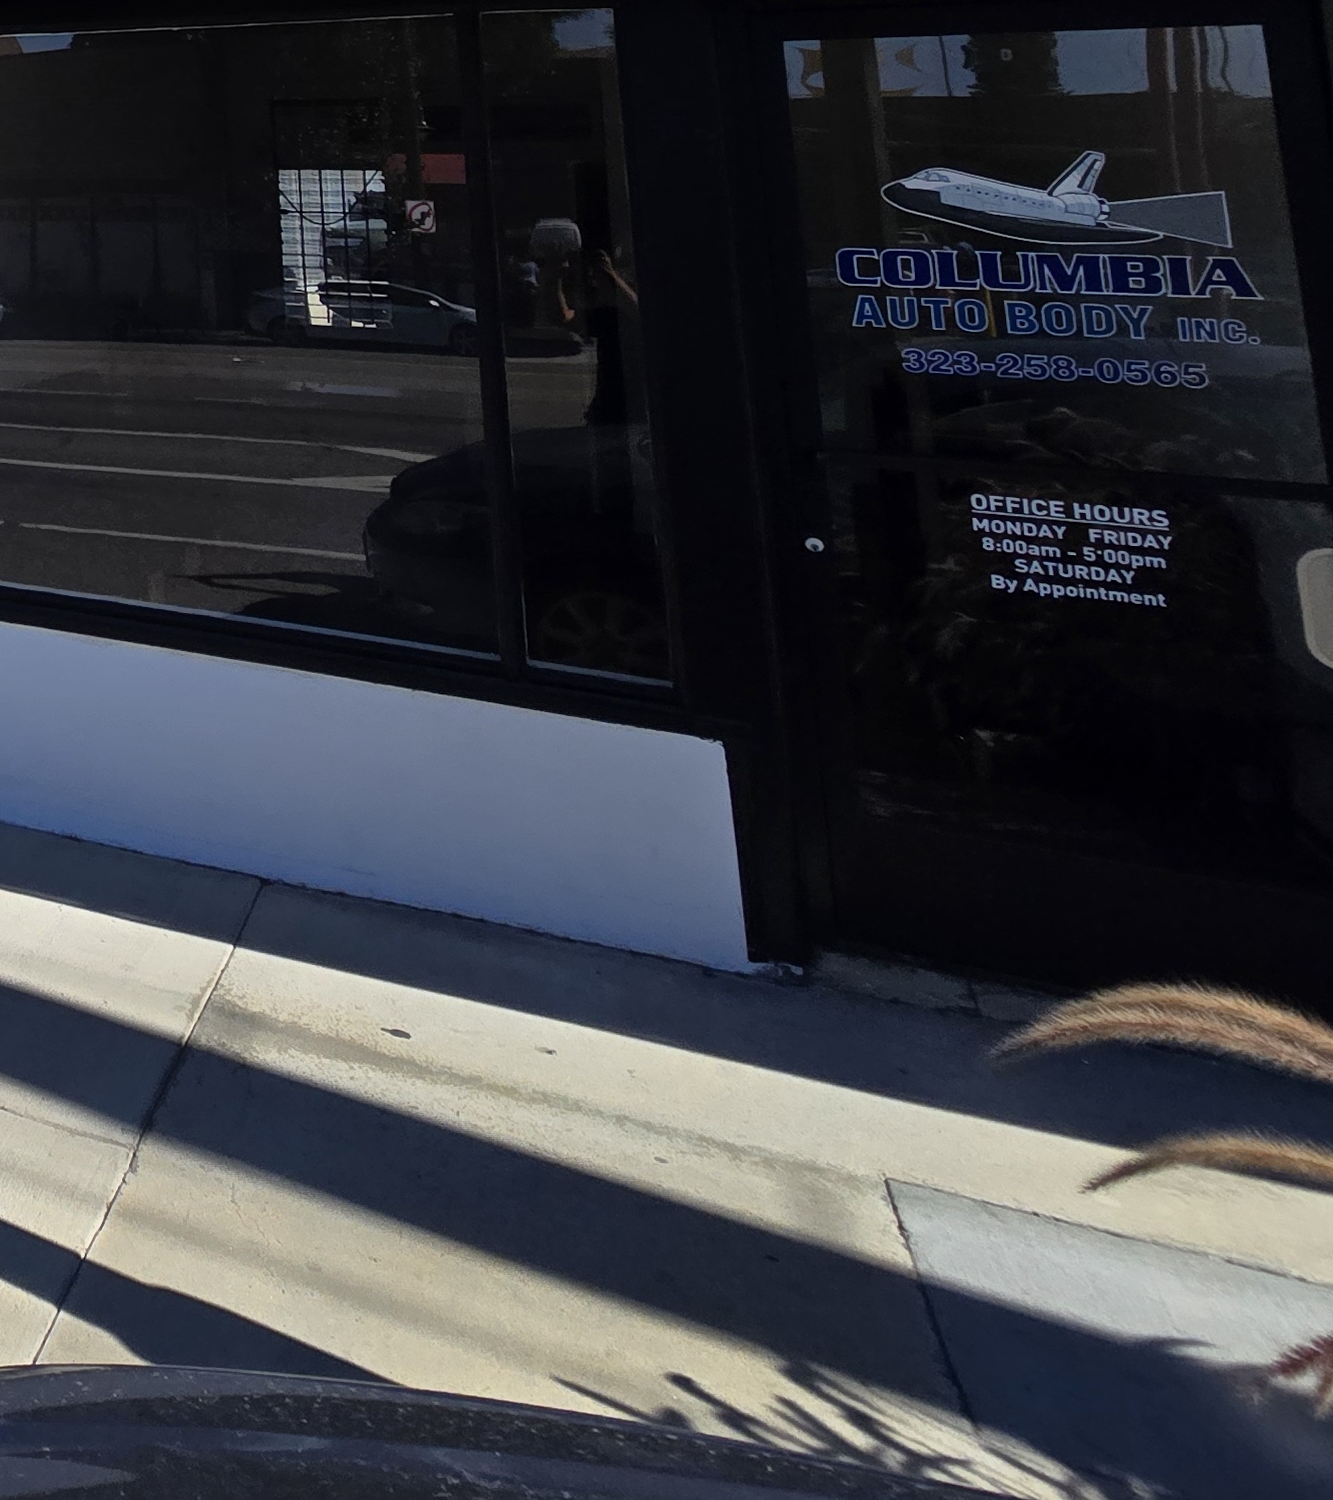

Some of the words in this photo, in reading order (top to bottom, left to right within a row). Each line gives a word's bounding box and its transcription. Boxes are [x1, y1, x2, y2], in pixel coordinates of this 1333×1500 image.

[835, 248, 1265, 300] COLUMBIA
[852, 295, 989, 333] AUTO
[1003, 300, 1153, 340] BODY
[1177, 317, 1261, 345] INC.
[901, 348, 1209, 389] 323-258-0565
[970, 493, 1066, 518] OFFICE
[1072, 502, 1170, 528] HOURS
[971, 518, 1066, 540] MONDAY
[1088, 528, 1173, 550] FRIDAY
[982, 537, 1061, 558] 8:00am
[1014, 558, 1135, 585] SATURDAY
[990, 574, 1018, 593] By
[1023, 578, 1168, 608] Appointment
